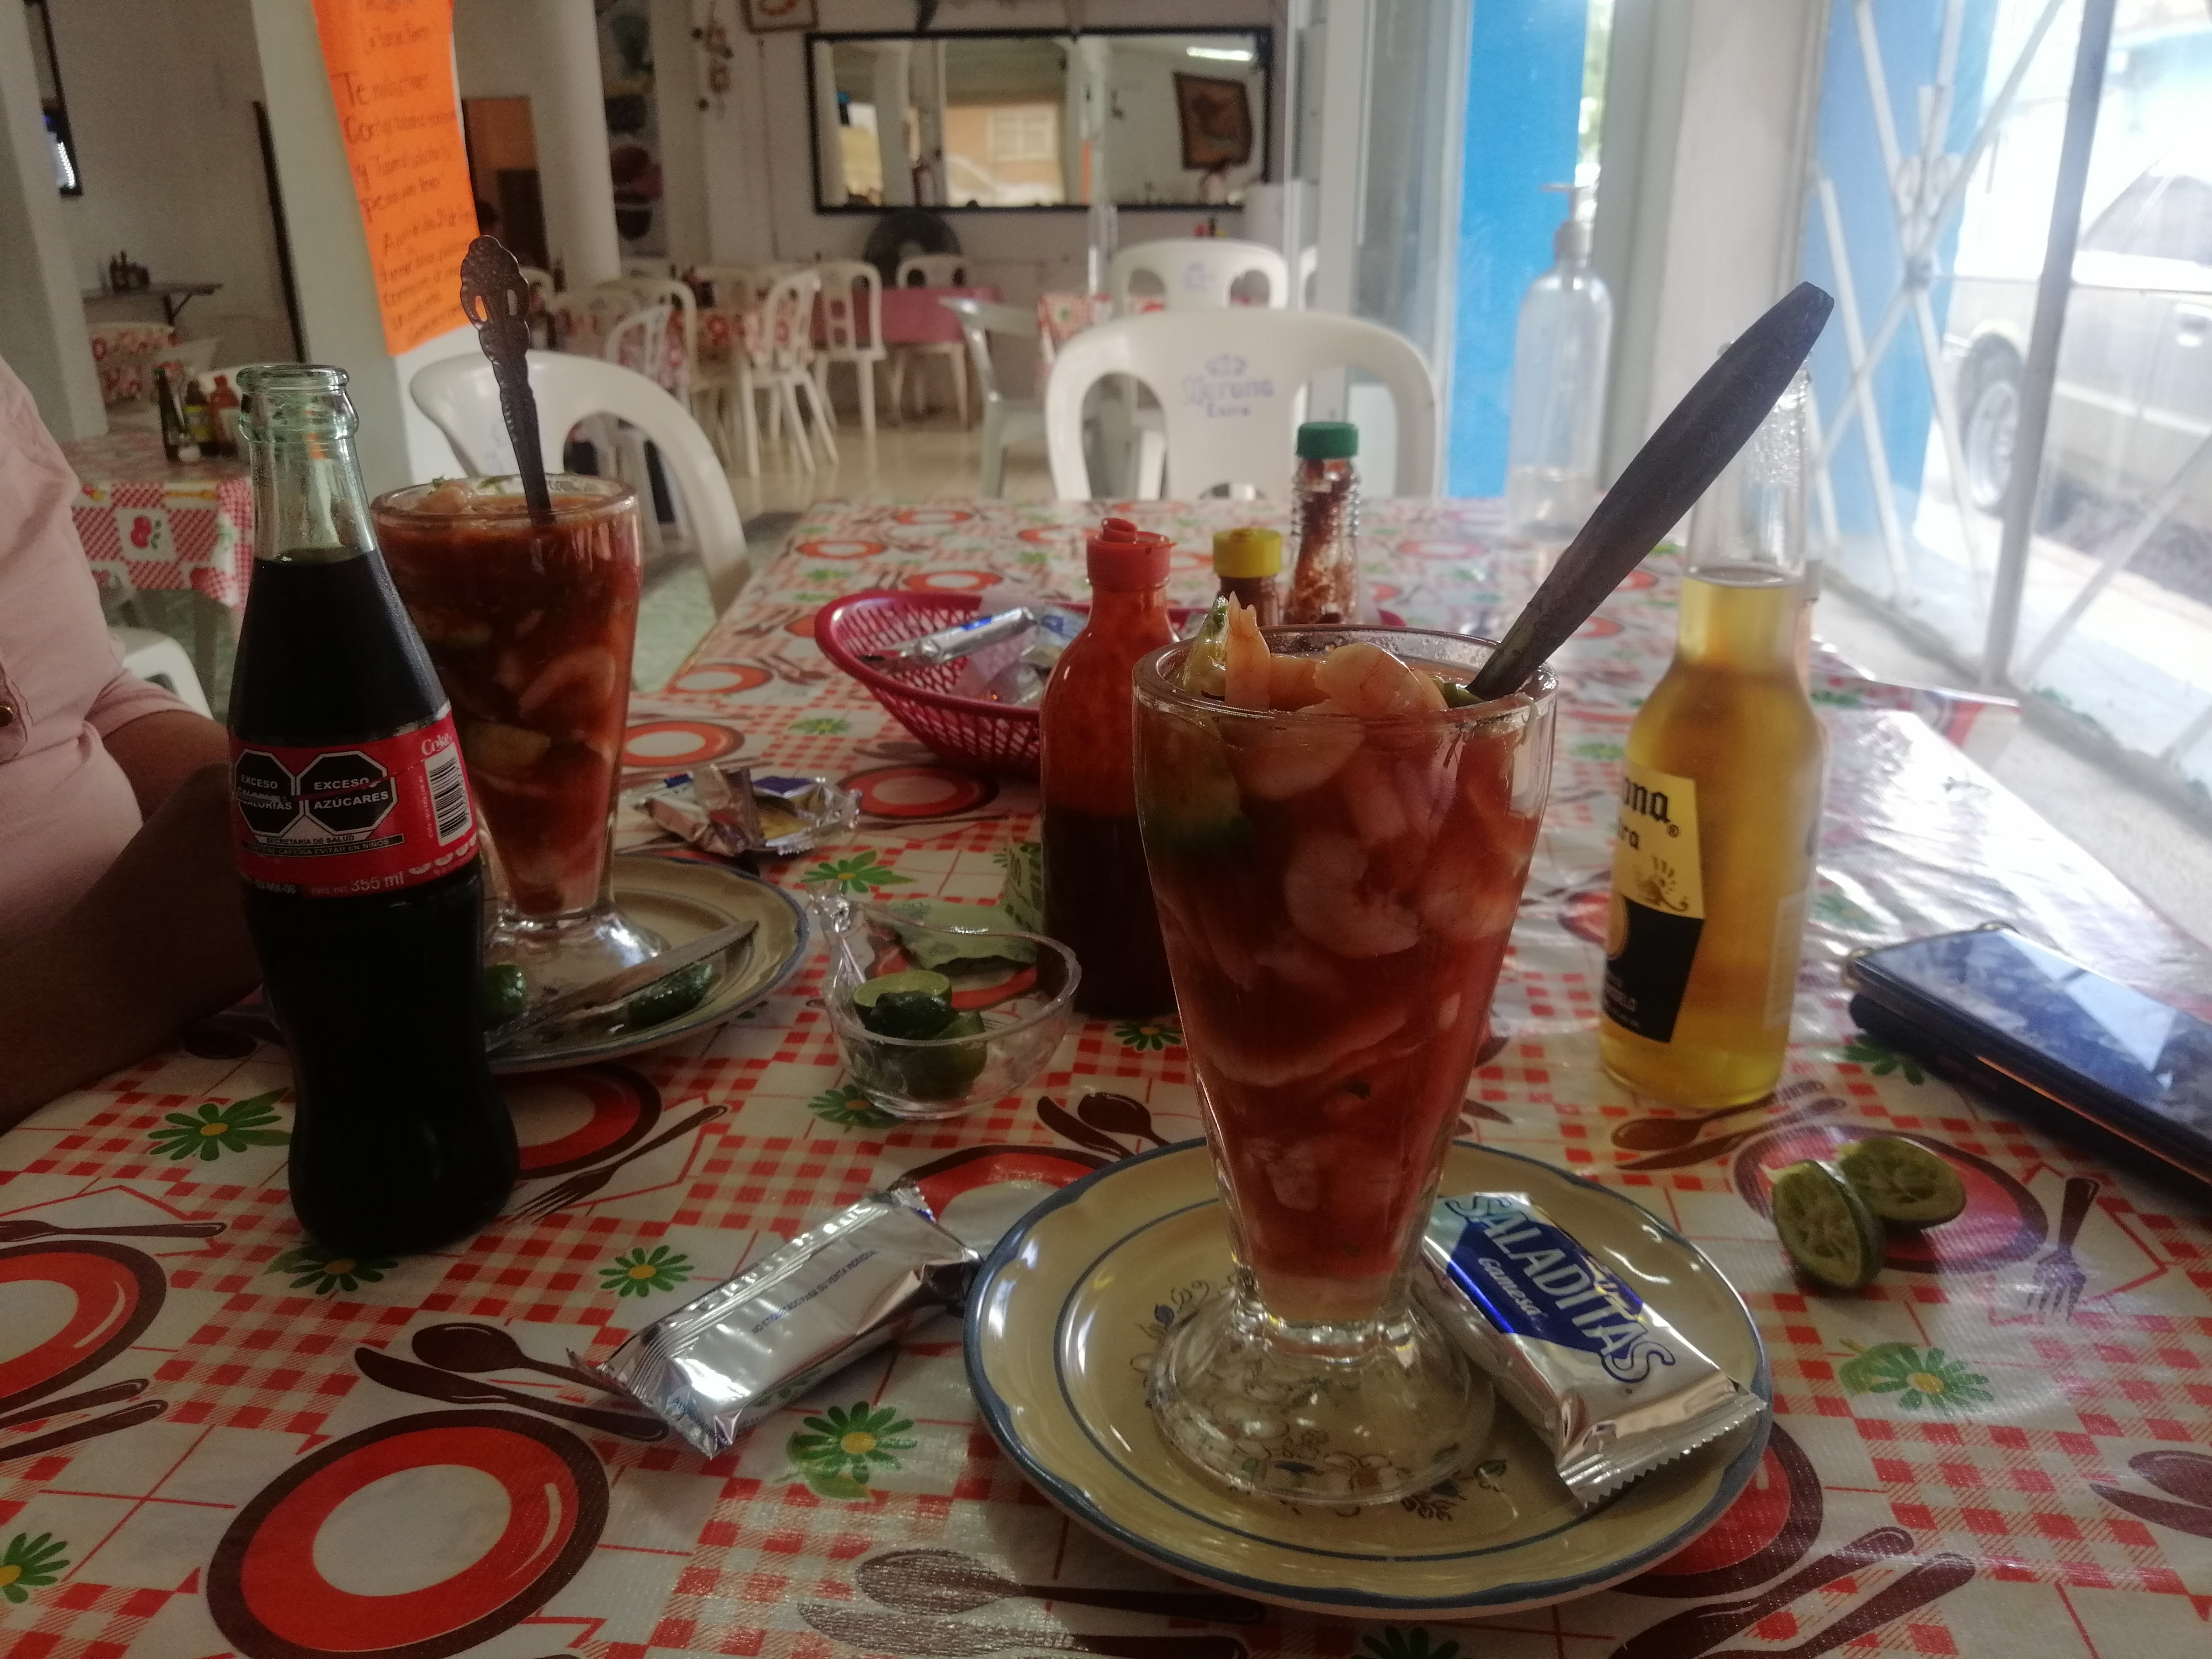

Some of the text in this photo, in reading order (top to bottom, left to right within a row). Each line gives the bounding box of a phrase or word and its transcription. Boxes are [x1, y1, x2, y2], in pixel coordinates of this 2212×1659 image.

[241, 774, 278, 788] EXCESO
[314, 777, 370, 790] EXCESO
[313, 791, 389, 809] AZÚCARES
[327, 835, 355, 843] SALUD
[351, 877, 381, 892] 355
[384, 871, 405, 887] ml
[1446, 1195, 1676, 1383] SALADITAS
